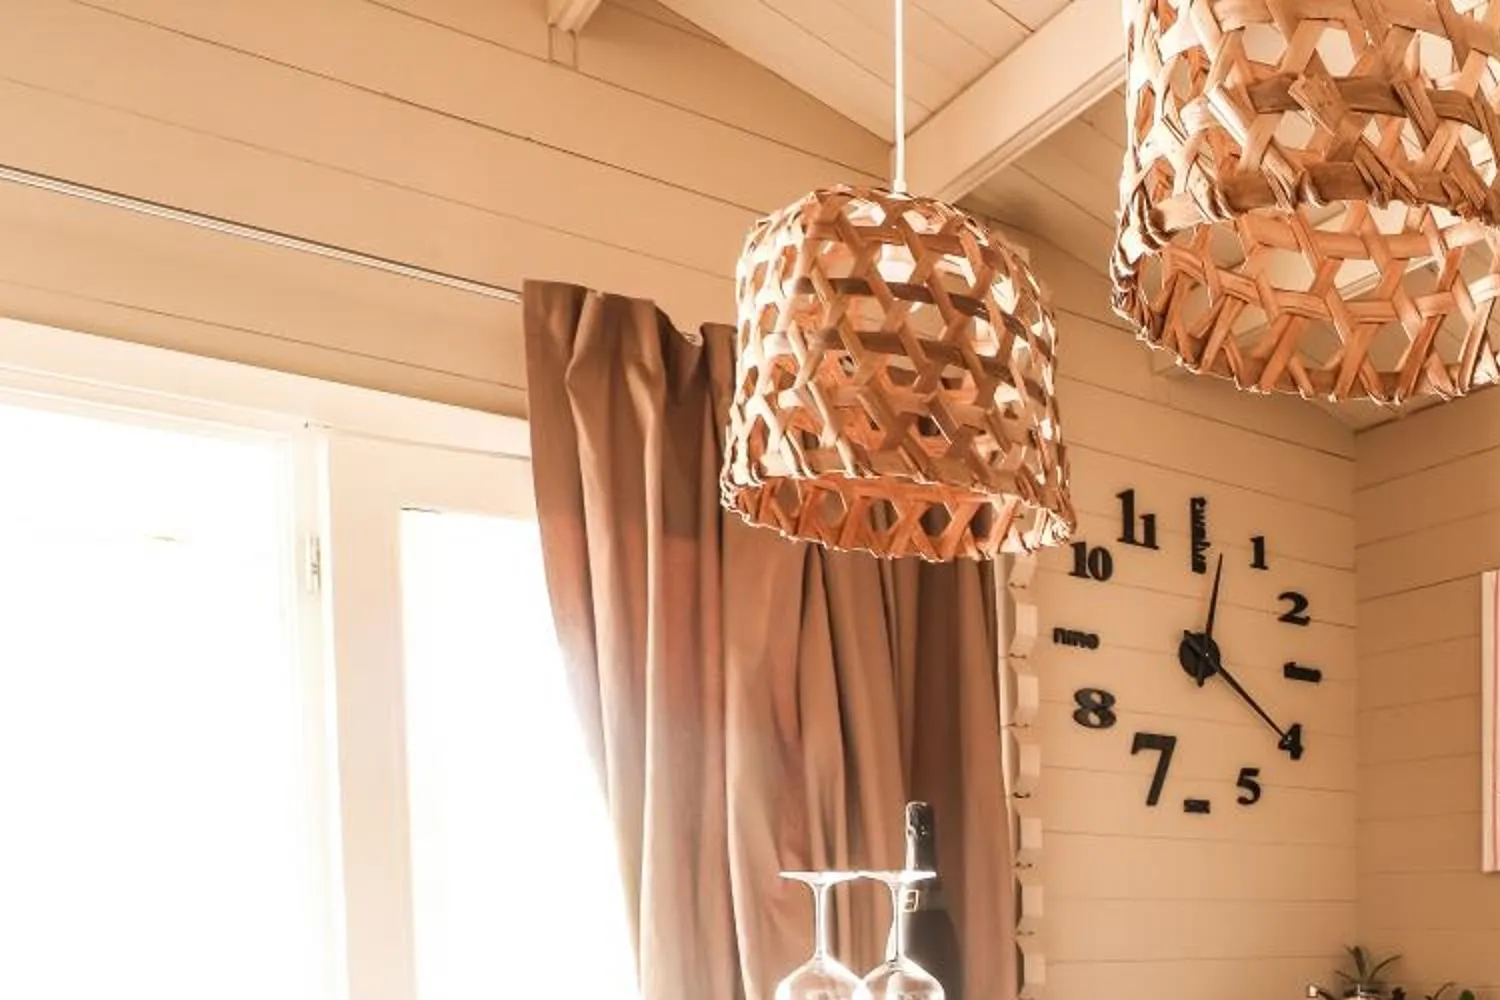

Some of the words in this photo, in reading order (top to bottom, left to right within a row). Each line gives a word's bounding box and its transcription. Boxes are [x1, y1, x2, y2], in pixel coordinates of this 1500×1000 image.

[1115, 489, 1159, 550] 11
[1068, 541, 1113, 581] 10
[1249, 536, 1269, 570] 1
[1277, 591, 1310, 626] 2
[1072, 688, 1116, 729] 8
[1277, 723, 1304, 760] 4
[1131, 732, 1177, 806] 7
[1236, 767, 1261, 806] 5
